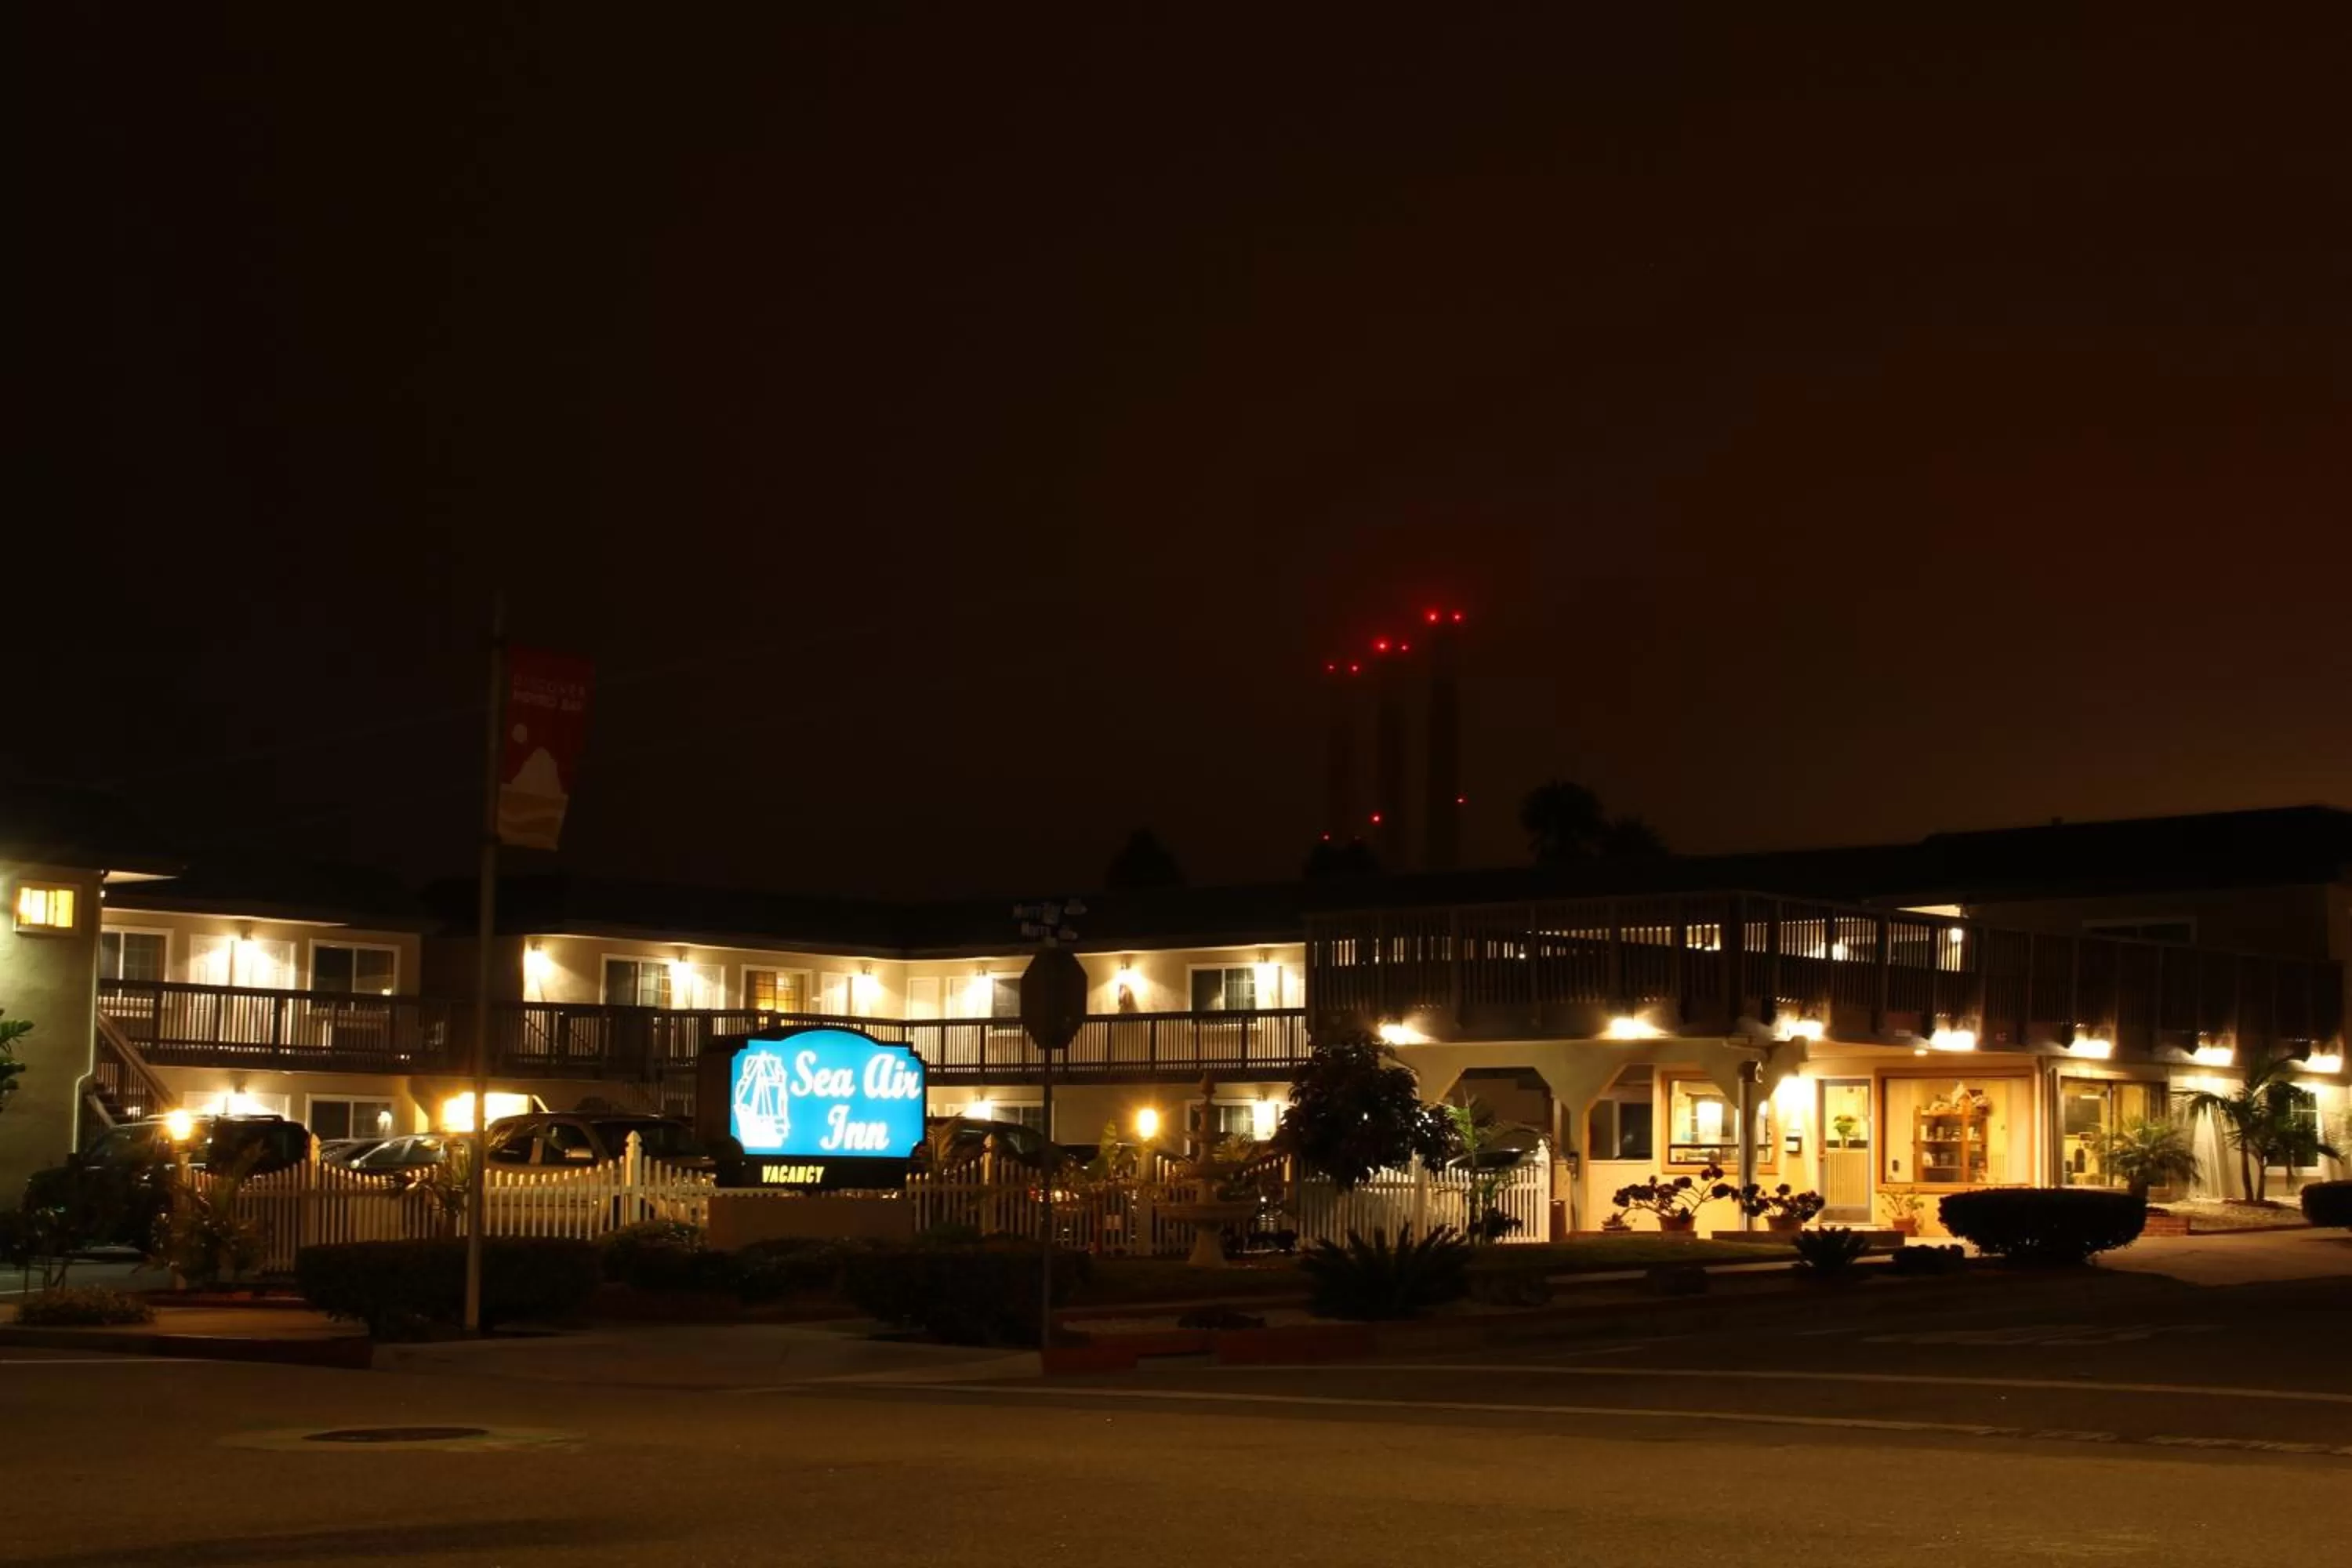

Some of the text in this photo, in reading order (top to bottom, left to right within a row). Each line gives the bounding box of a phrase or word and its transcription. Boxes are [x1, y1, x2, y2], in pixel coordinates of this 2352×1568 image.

[789, 1050, 922, 1099] Sea Air
[818, 1104, 890, 1150] Inn
[761, 1164, 826, 1184] VACANCY
